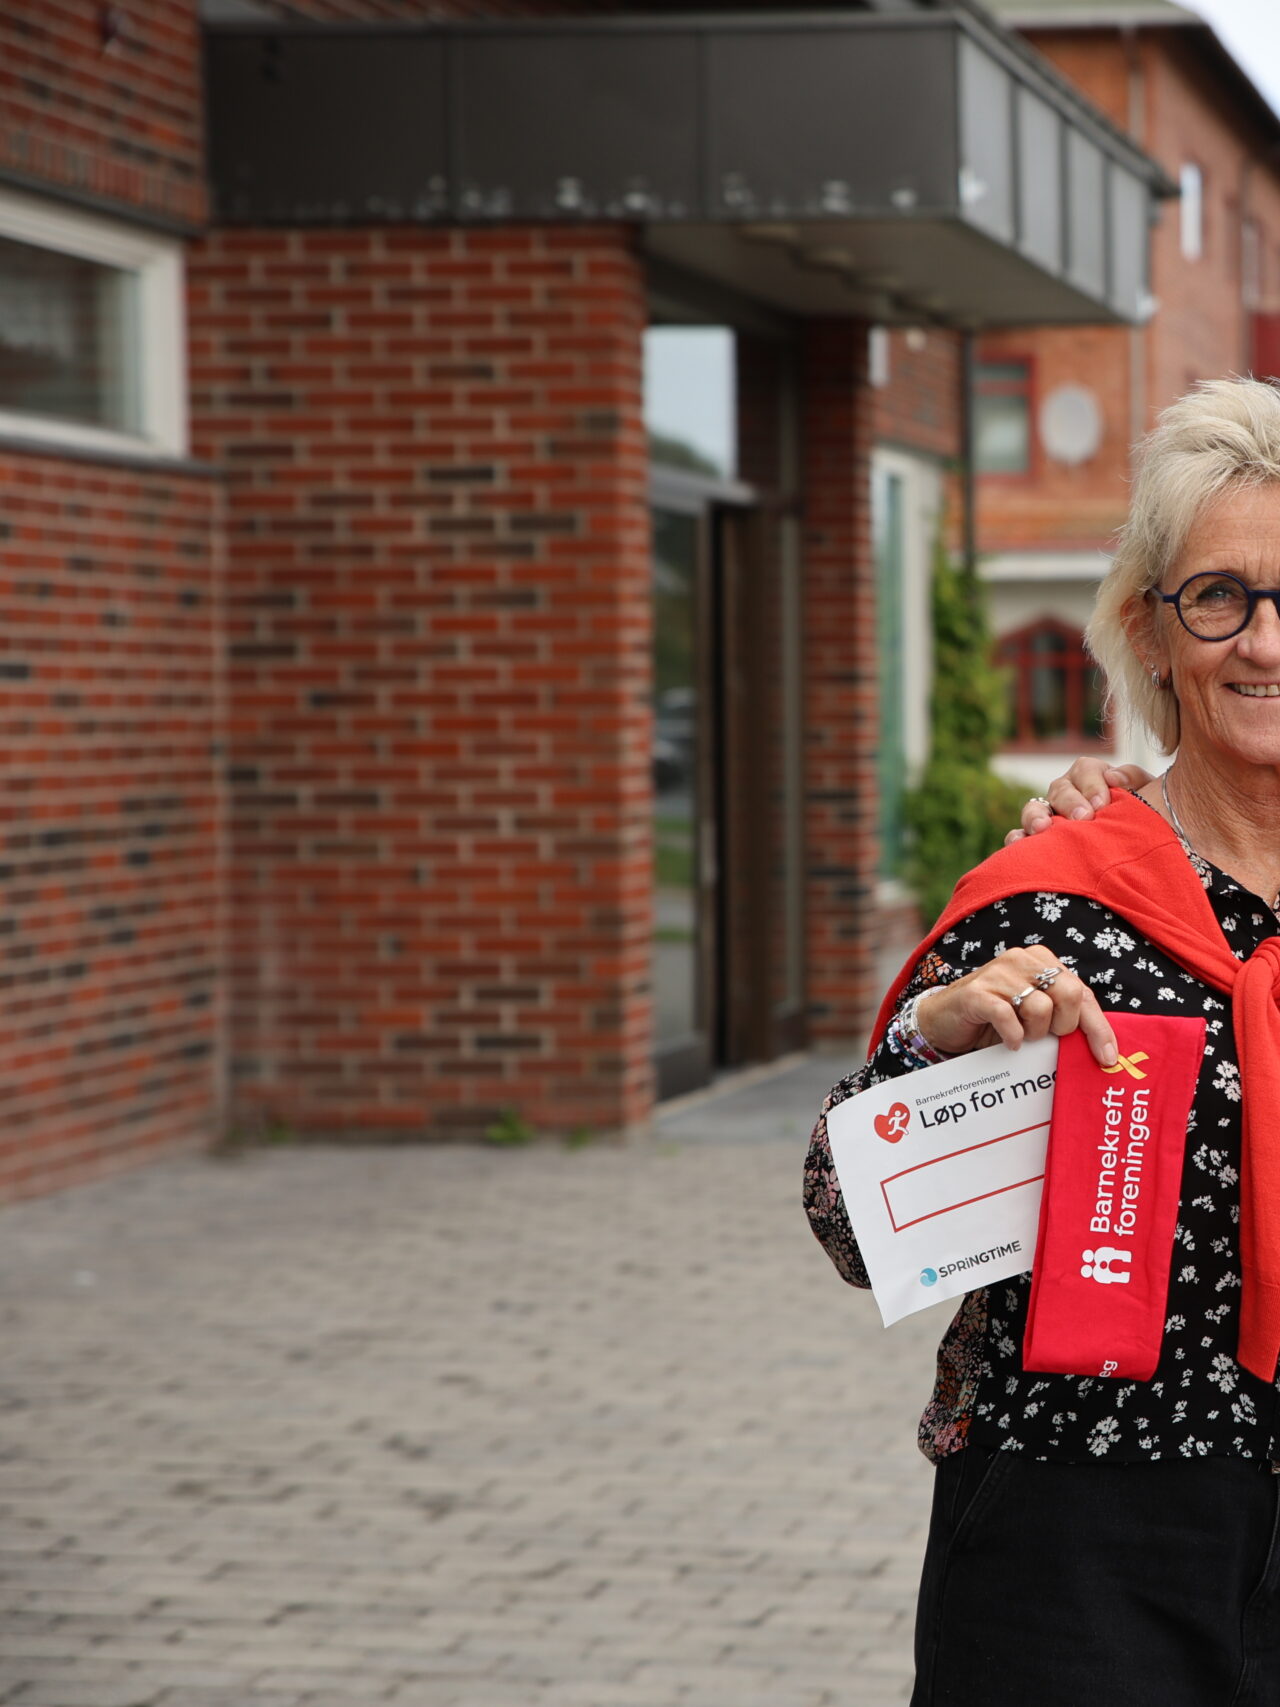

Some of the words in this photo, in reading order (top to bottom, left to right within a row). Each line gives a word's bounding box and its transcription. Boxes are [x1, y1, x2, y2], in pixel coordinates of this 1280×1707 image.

[915, 1070, 1011, 1107] Barnekreftforeningens
[919, 1101, 967, 1129] Løp
[969, 1089, 1006, 1112] for
[1089, 1086, 1126, 1233] Barnekreft
[1113, 1088, 1151, 1237] foreningen
